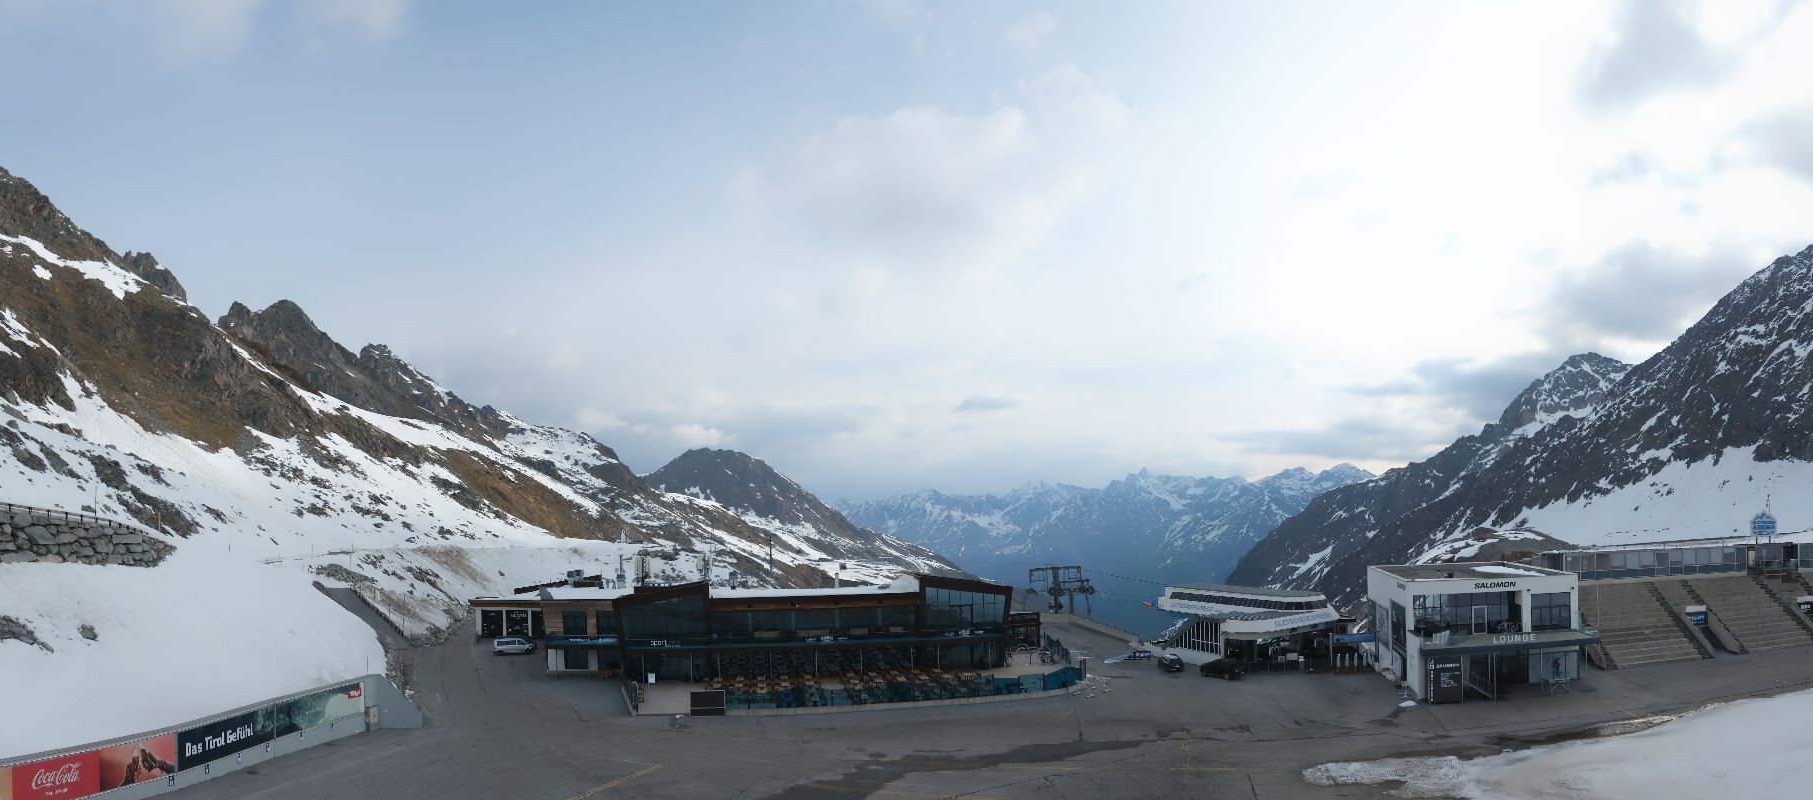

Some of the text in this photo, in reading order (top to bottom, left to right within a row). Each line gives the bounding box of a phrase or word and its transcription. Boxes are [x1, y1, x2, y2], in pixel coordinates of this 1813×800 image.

[1474, 581, 1516, 589] SALOMON
[1493, 633, 1536, 644] LOUNGE
[185, 722, 254, 758] Das Tirol Gefühl
